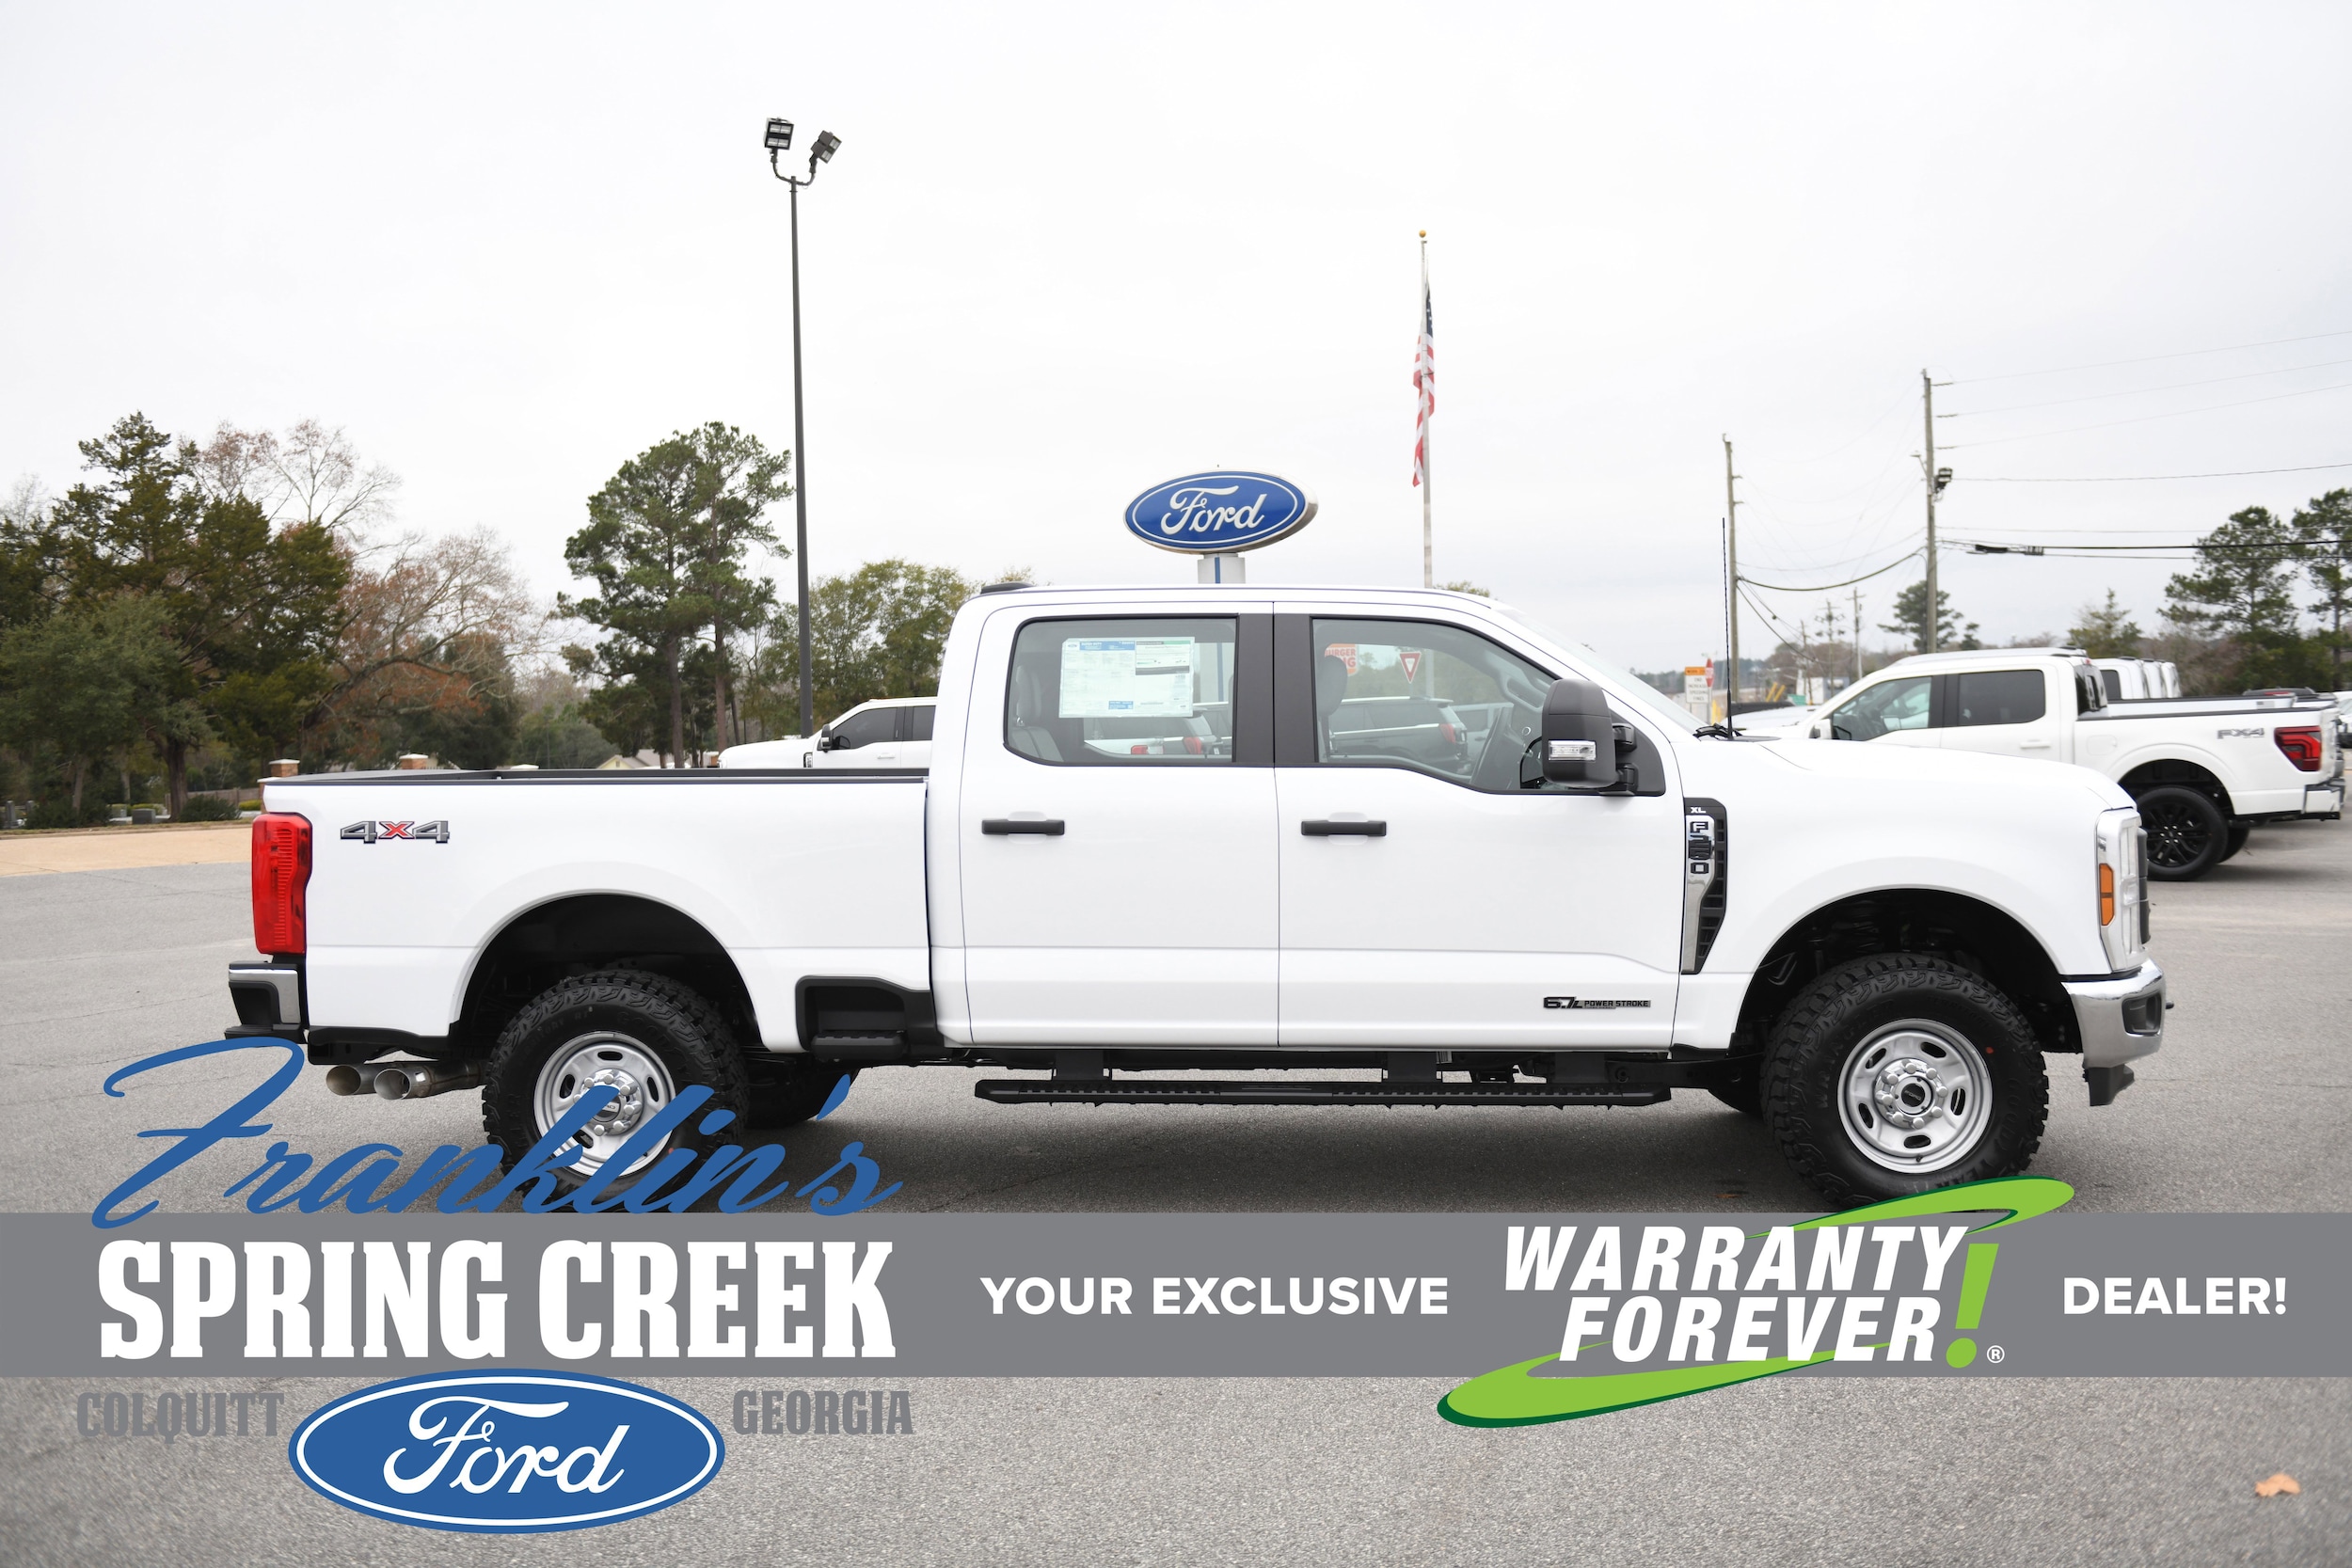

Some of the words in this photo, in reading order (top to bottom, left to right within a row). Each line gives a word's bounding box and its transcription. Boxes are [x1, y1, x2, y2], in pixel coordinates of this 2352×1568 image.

[1160, 484, 1268, 535] Ford
[2217, 727, 2265, 740] FX4
[1543, 996, 1583, 1009] 6.7L
